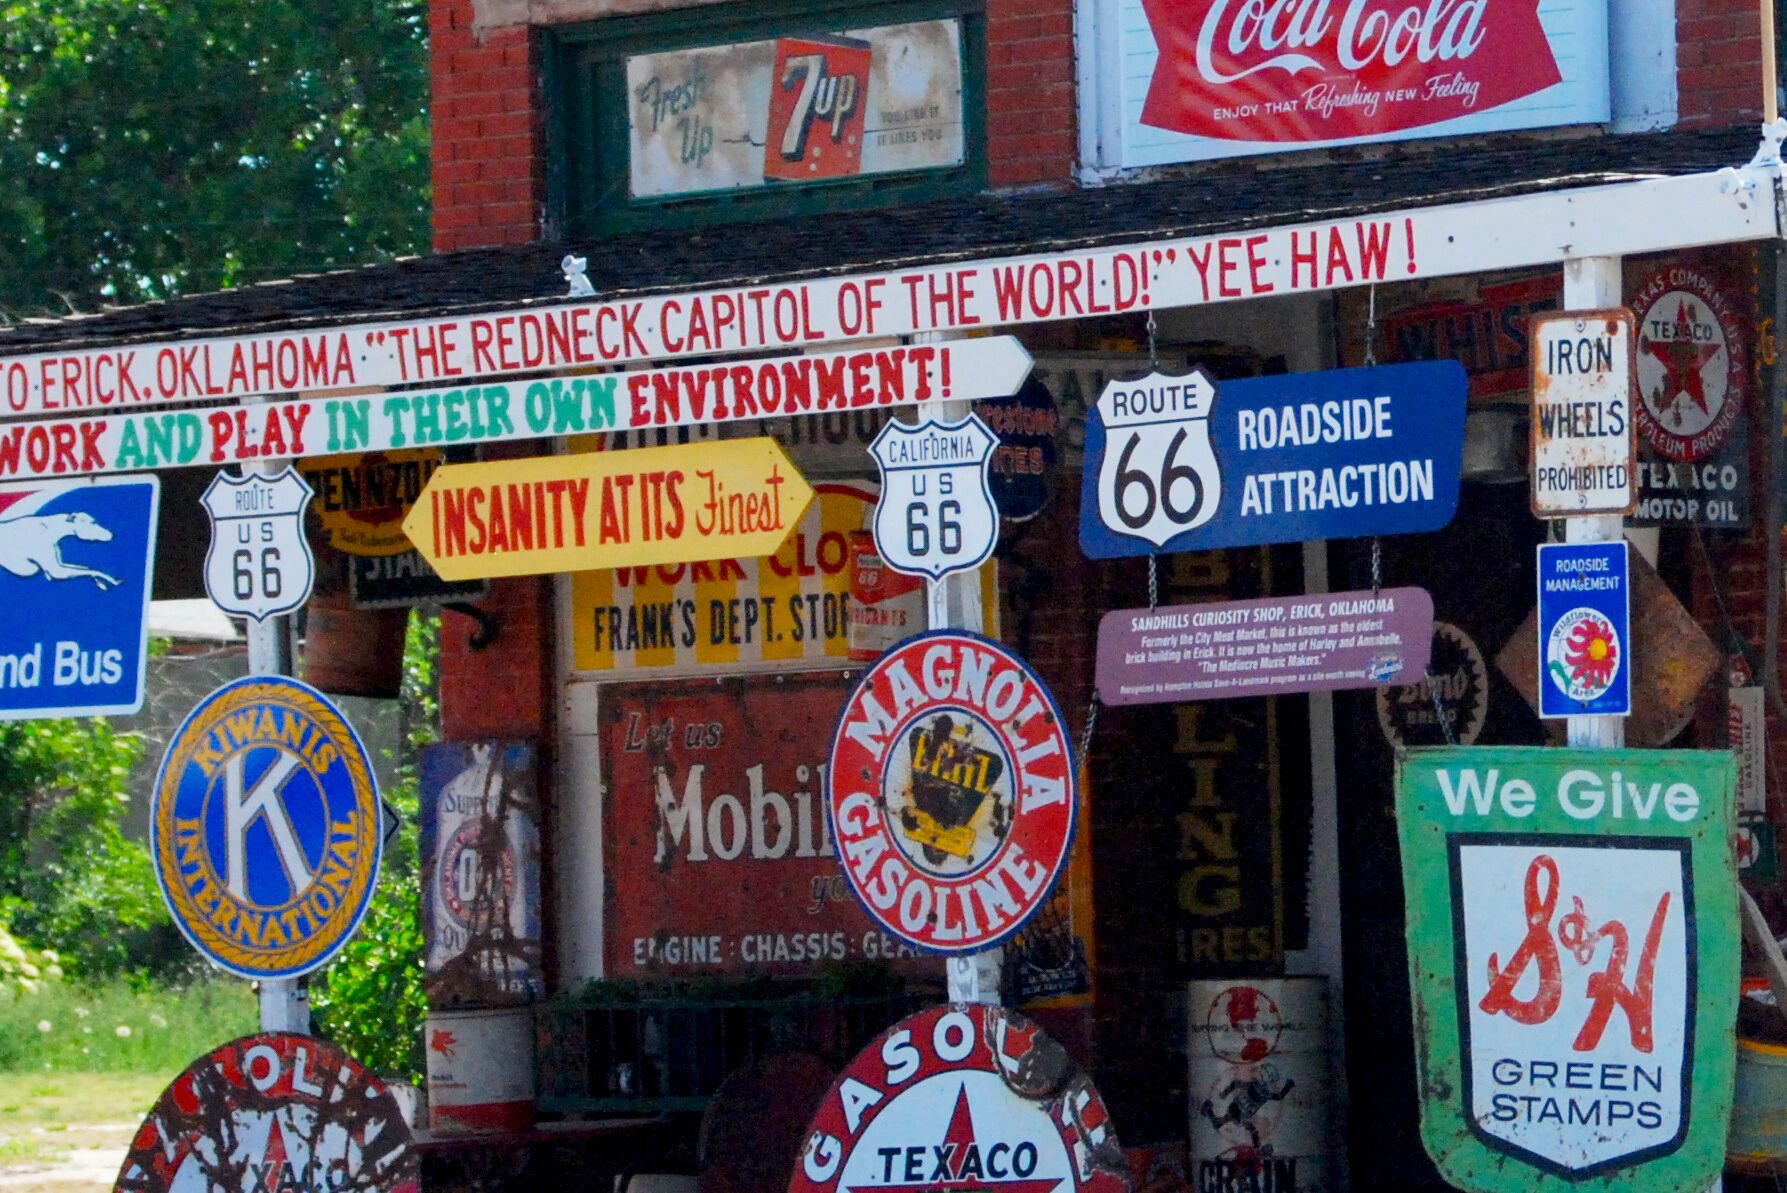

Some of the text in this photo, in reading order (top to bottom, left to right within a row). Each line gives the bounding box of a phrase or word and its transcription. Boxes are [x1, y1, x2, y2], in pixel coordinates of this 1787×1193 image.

[1213, 107, 1259, 121] ENJOY
[1264, 101, 1299, 114] THAT
[1301, 76, 1380, 119] Refreshing
[1385, 89, 1417, 102] NEW
[1421, 72, 1480, 107] Feeling
[156, 332, 355, 398] OKLAHOMA
[470, 302, 654, 373] REDNECK
[660, 286, 825, 361] CAPITOL
[838, 278, 886, 335] OF
[902, 269, 980, 329] THE
[1187, 235, 1274, 301] YEE
[1650, 320, 1713, 341] TEXACO
[1547, 337, 1612, 375] IRON
[115, 413, 203, 468] AND
[208, 403, 311, 462] PLAY
[325, 399, 371, 449] IN
[383, 385, 516, 446] THEIR
[525, 376, 618, 434] OWN
[628, 347, 951, 427] ENVIRONMENT!
[1113, 384, 1198, 417] ROUTE
[1238, 396, 1393, 451] ROADSIDE
[1538, 400, 1625, 439] WHEELS
[888, 435, 975, 463] CALIFORNIA
[235, 486, 274, 512] ROUTE
[1113, 427, 1205, 529] 66
[1240, 459, 1435, 517] ATTRACTION
[1538, 465, 1627, 491] PROHIBITED
[431, 464, 785, 558] INSANITY AT ITS Finest
[906, 500, 962, 557] 66
[1706, 500, 1739, 521] OIL
[232, 547, 282, 600] 66
[1545, 577, 1620, 592] MANAGEMENT
[1556, 557, 1610, 573] ROADSIDE
[594, 599, 697, 652] FRANK'S
[710, 596, 784, 645] DEPT.
[1131, 598, 1395, 632] SANDHILLS CURIOSITY SHOP, ERICK, OKLAHOMA
[53, 641, 122, 685] Bus
[192, 707, 339, 778] KIWANIS
[684, 722, 724, 749] us
[845, 644, 1067, 816] MAGNOLIA
[1435, 768, 1537, 818] We
[1557, 769, 1700, 822] Give
[224, 750, 317, 905] K
[176, 810, 359, 946] INTERNATIONAL
[838, 791, 1049, 940] GASOLINE
[1492, 1058, 1663, 1092] GREEN
[1492, 1094, 1662, 1129] STAMPS
[878, 1141, 1038, 1184] TEXACO
